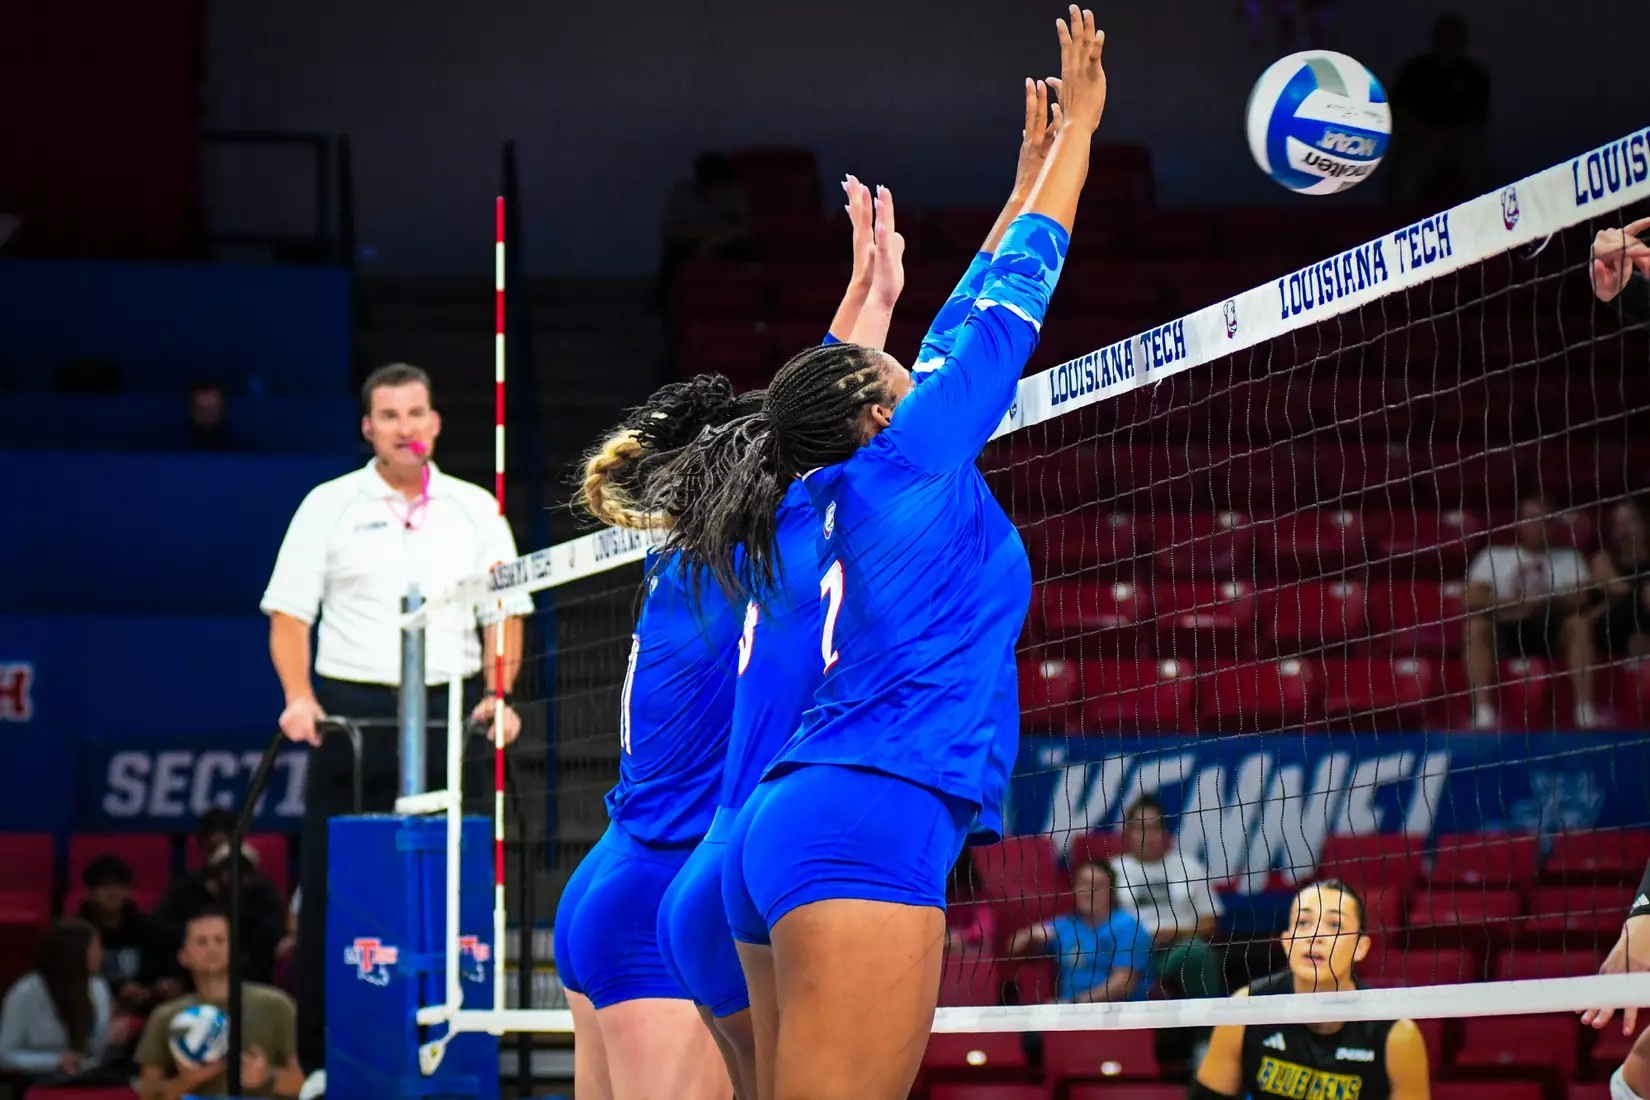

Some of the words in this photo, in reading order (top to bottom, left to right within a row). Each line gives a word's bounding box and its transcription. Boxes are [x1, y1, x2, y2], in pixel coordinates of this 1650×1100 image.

[1320, 130, 1377, 156] NCAA
[1278, 240, 1388, 320] LOUISIANA
[1394, 212, 1452, 274] TECH
[1049, 339, 1135, 406] LOUISIANA
[1140, 319, 1186, 372] TECH
